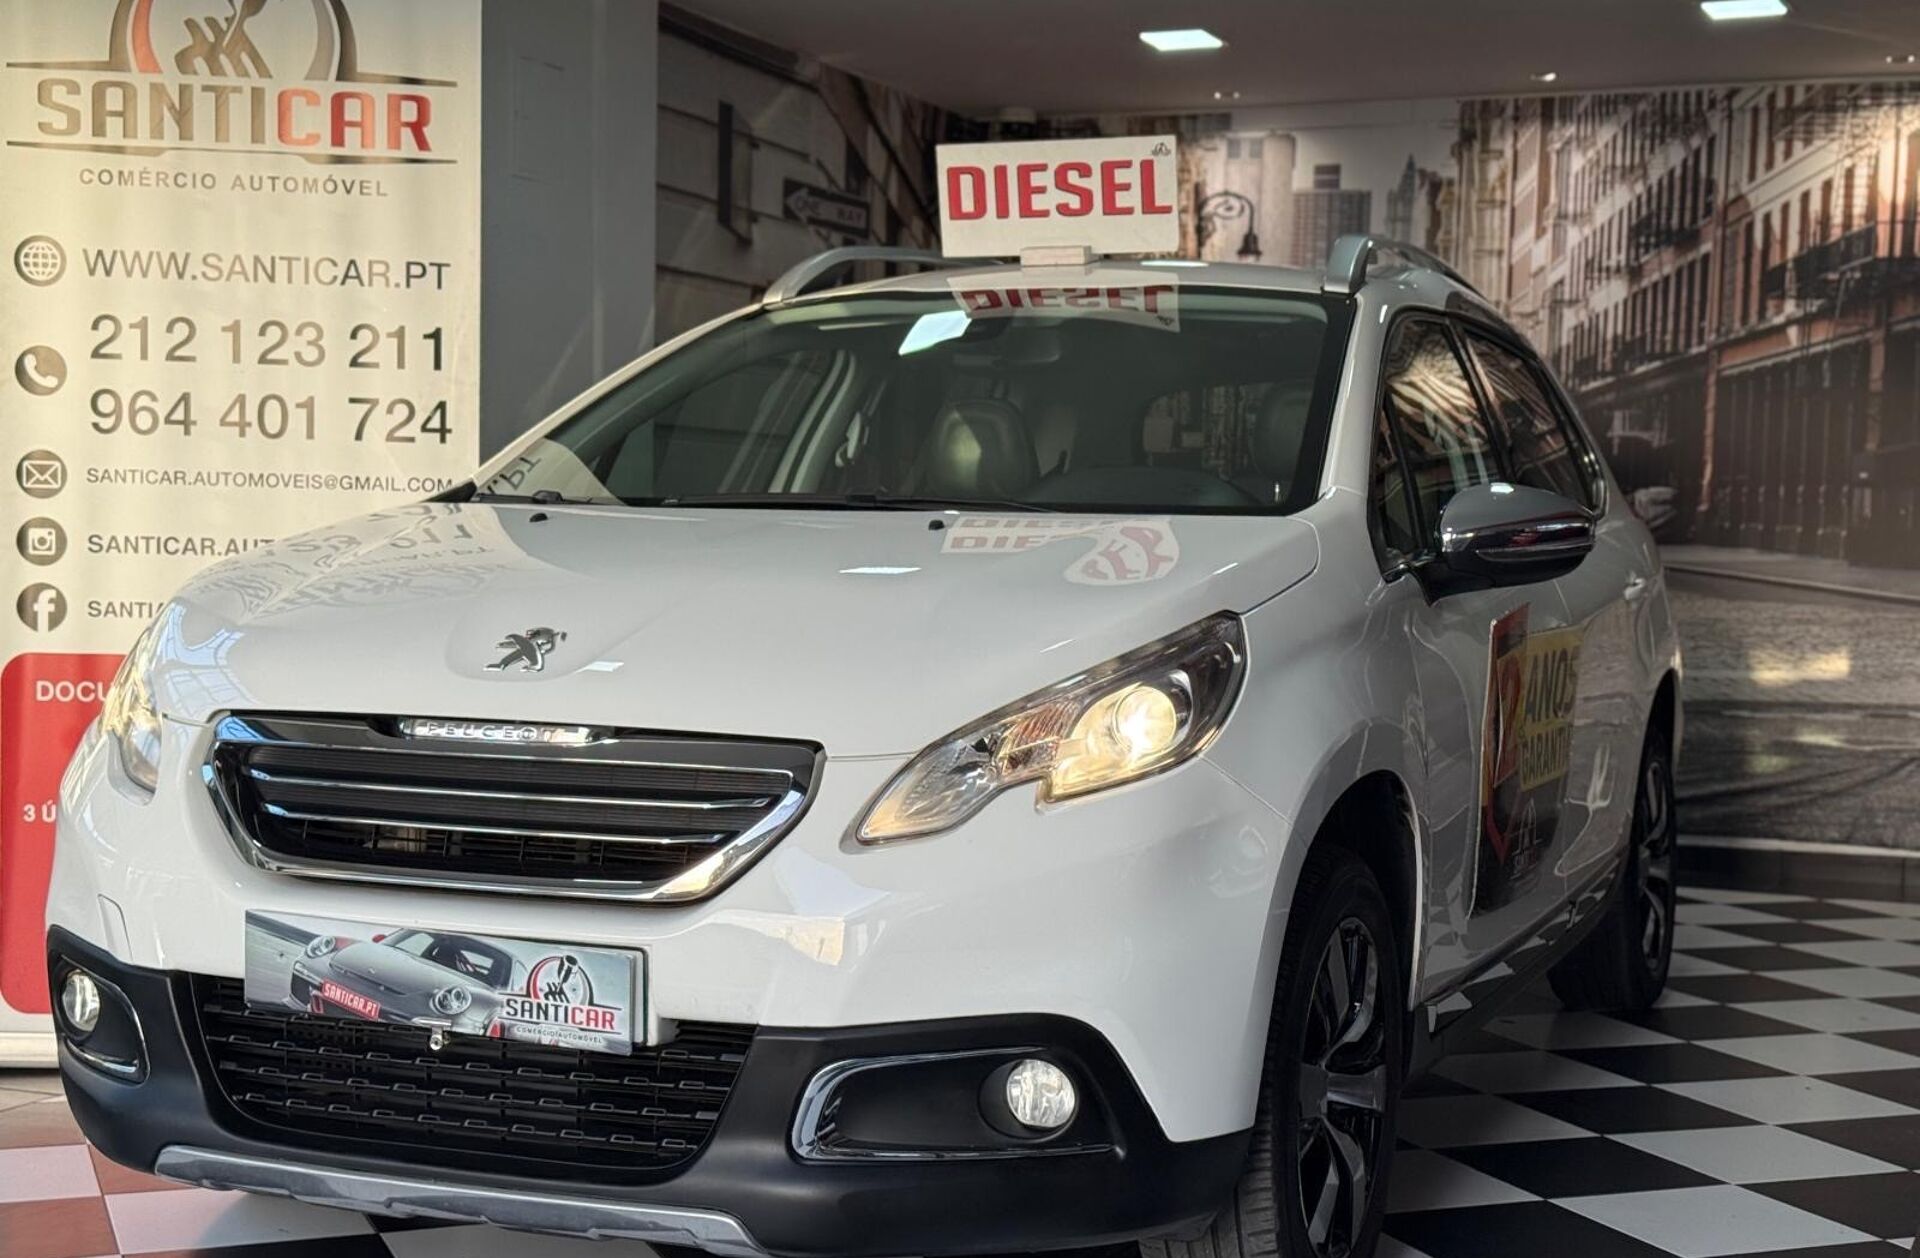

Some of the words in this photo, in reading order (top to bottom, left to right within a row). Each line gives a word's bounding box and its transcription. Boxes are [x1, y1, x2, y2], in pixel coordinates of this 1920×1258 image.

[37, 78, 432, 152] SANTICAR
[79, 167, 217, 190] COMÉRCIO
[231, 174, 389, 197] AUTOMÓVEL
[946, 158, 1173, 220] DIESEL
[83, 247, 451, 290] WWW.SANTICAR.PT
[90, 314, 197, 362] 212
[220, 319, 326, 367] 123
[348, 323, 443, 371] 211
[90, 388, 197, 436] 964
[219, 393, 316, 440] 401
[348, 397, 453, 444] 724
[86, 468, 452, 493] SANTICAR.AUTOMOVEIS@GMAIL.COM
[427, 722, 556, 743] PEUGEOT
[23, 803, 36, 822] 3
[324, 983, 377, 1017] SANTICAR.PT
[505, 998, 615, 1030] SANTICAR
